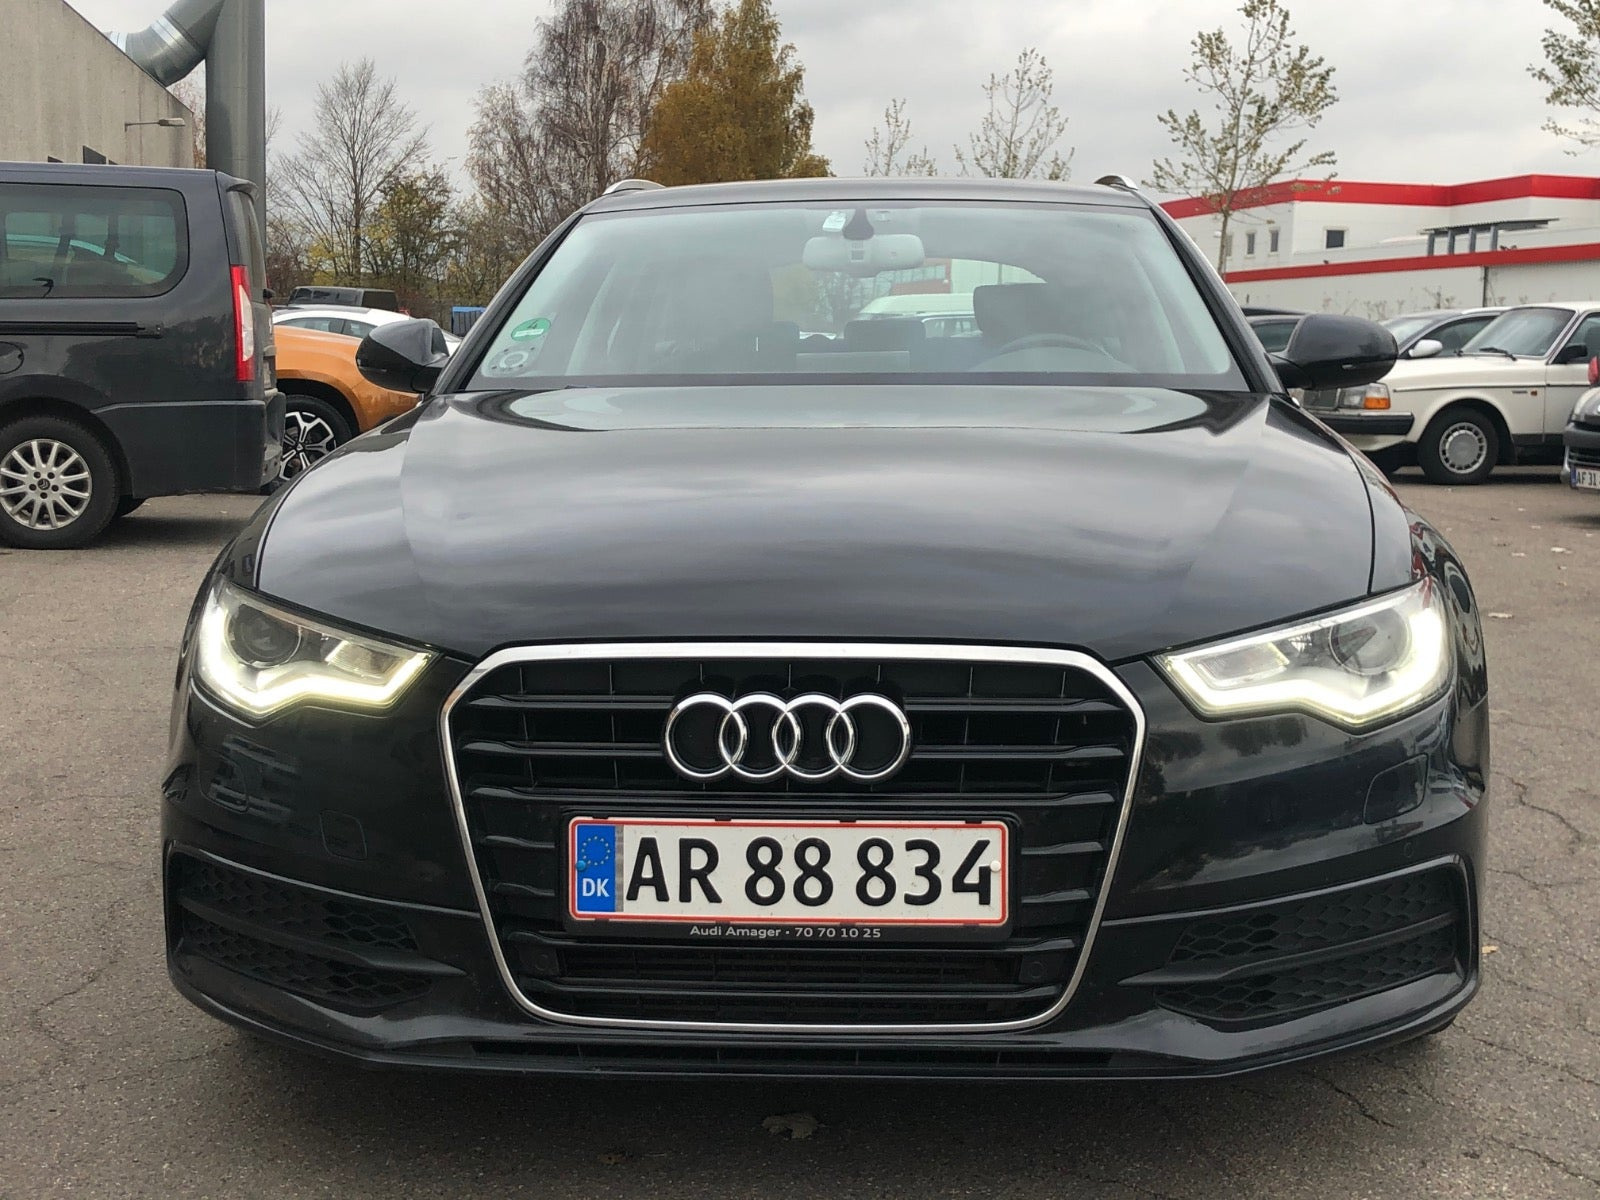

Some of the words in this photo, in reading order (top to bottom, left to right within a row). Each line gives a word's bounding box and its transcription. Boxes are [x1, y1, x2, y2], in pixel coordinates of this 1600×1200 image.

[626, 837, 723, 903] AR
[745, 836, 834, 906] 88
[856, 837, 991, 906] 834
[582, 877, 609, 898] DK
[690, 925, 722, 936] Audi
[725, 926, 782, 939] Amager
[794, 927, 813, 938] 70
[817, 927, 836, 938] 70
[840, 928, 859, 938] 10
[863, 928, 881, 938] 25
